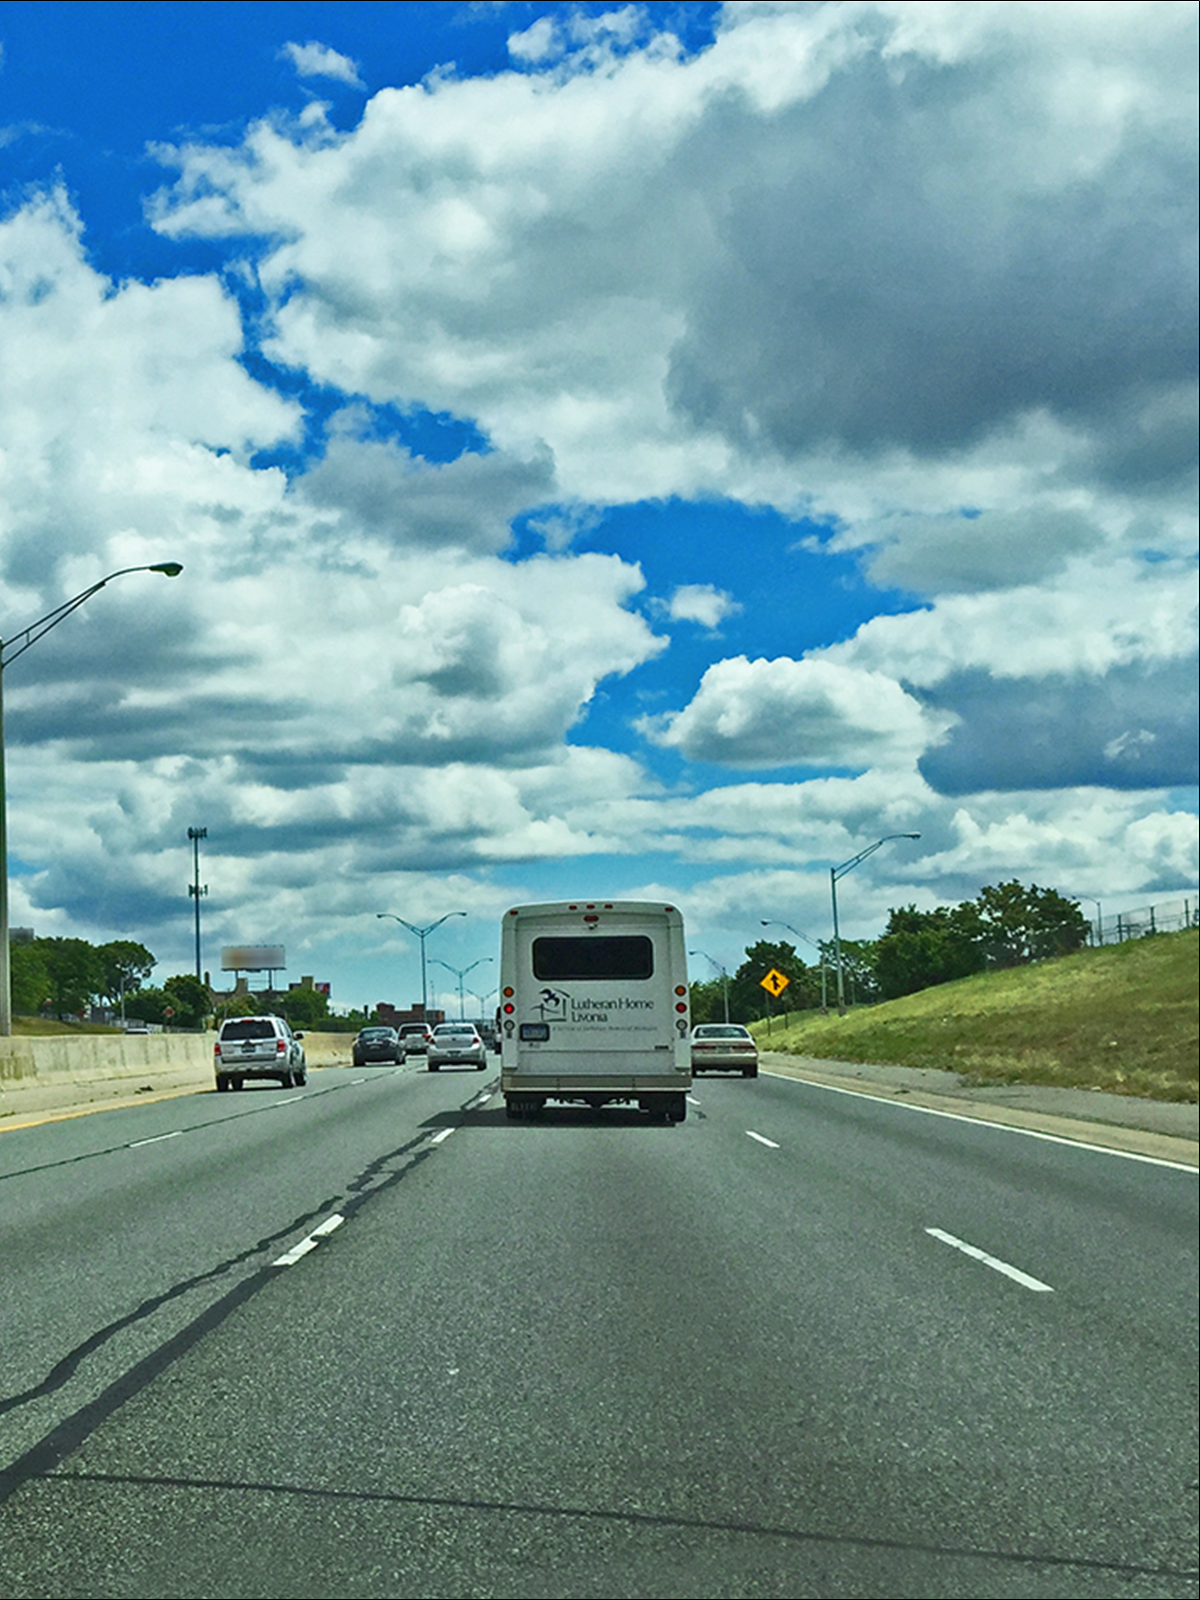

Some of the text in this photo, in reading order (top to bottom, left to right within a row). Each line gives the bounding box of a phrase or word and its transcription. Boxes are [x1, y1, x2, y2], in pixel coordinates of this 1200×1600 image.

[571, 998, 655, 1010] Lutheran Home
[571, 1011, 608, 1023] Livonia
